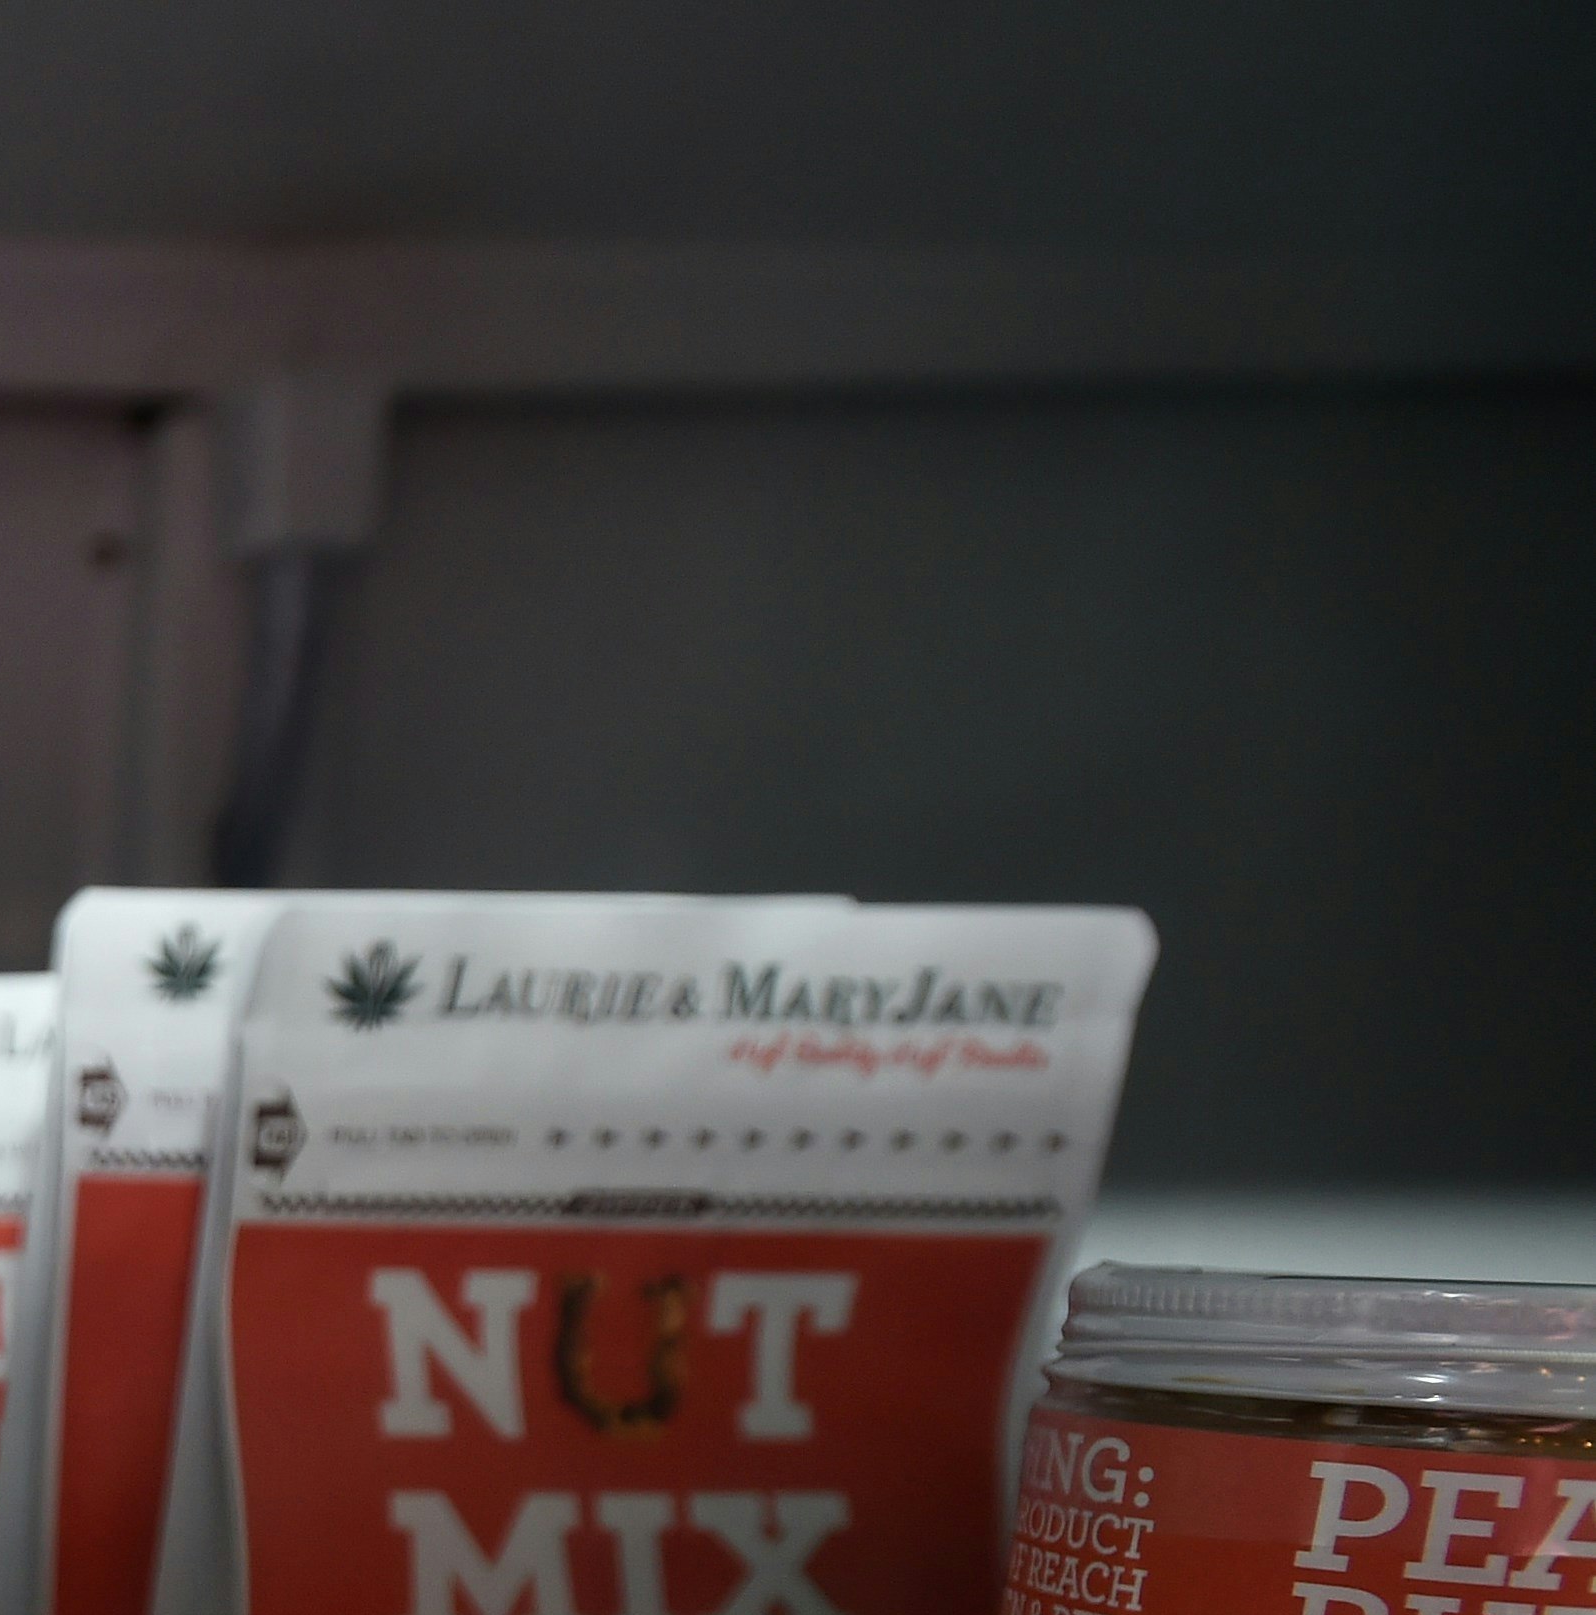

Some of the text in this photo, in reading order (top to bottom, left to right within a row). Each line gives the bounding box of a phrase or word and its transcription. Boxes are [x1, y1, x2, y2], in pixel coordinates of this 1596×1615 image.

[437, 954, 664, 1024] LAURIE
[720, 960, 1065, 1026] MARYJANE
[370, 1266, 860, 1443] NUT
[1028, 1546, 1149, 1612] REACH
